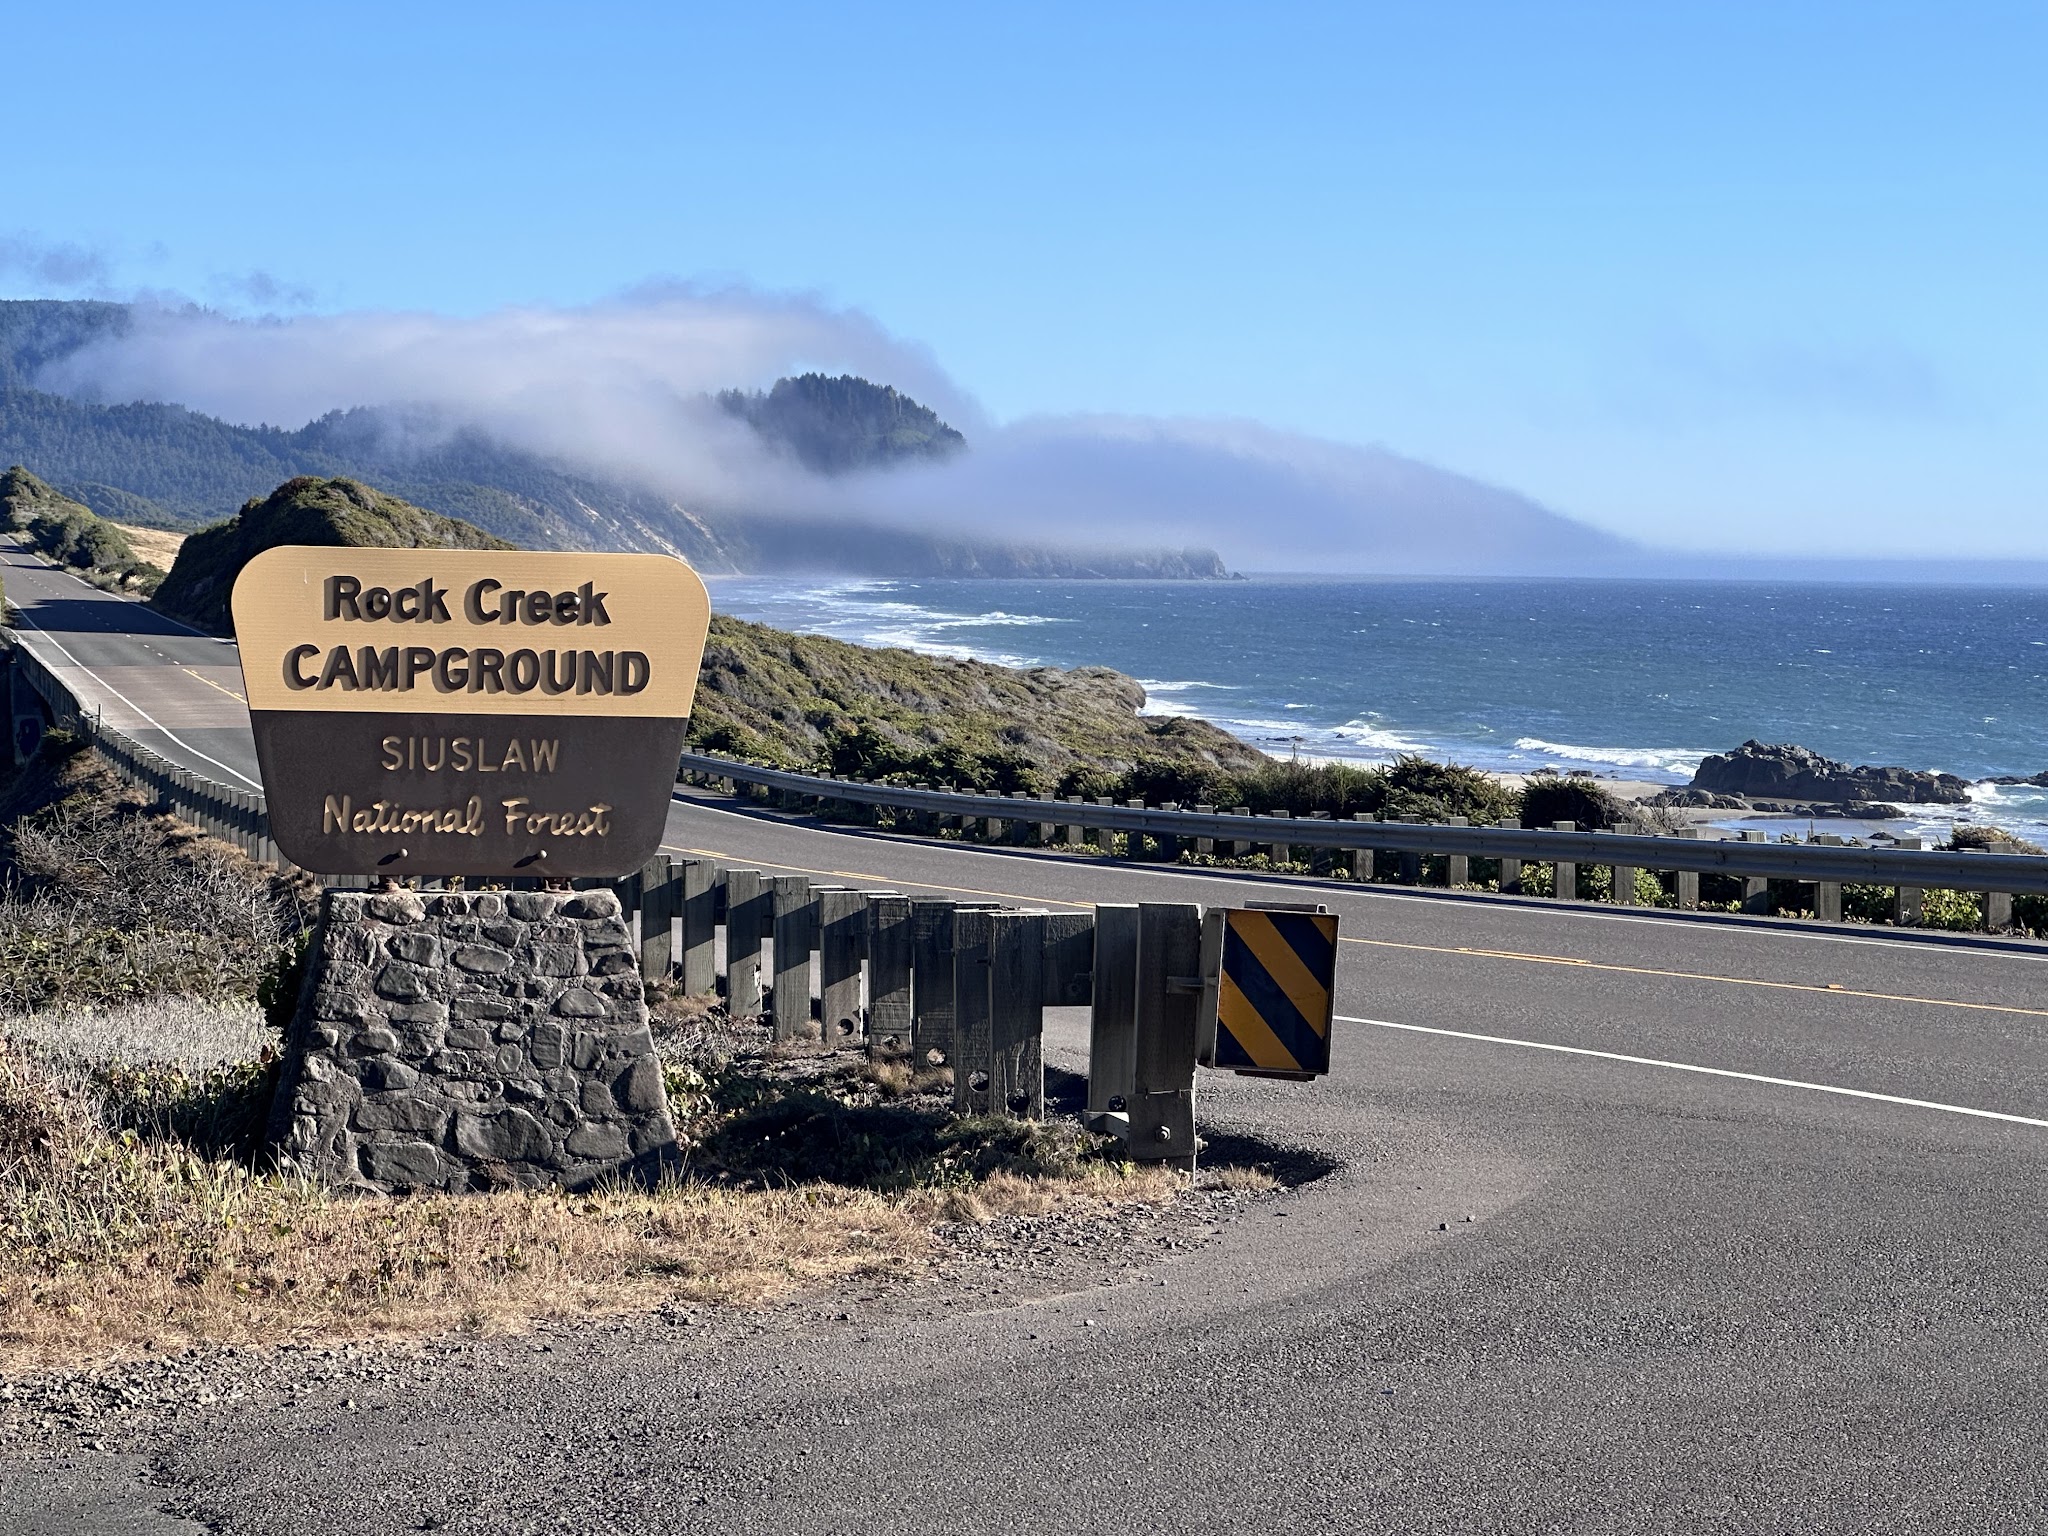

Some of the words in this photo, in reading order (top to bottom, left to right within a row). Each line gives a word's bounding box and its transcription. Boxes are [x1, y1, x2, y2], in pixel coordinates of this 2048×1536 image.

[326, 575, 452, 622] Rock
[466, 578, 611, 625] Creek
[285, 643, 651, 694] CAMPGROUND
[380, 736, 560, 773] SIUSLAW
[323, 794, 484, 836] National
[502, 798, 612, 837] Forest
